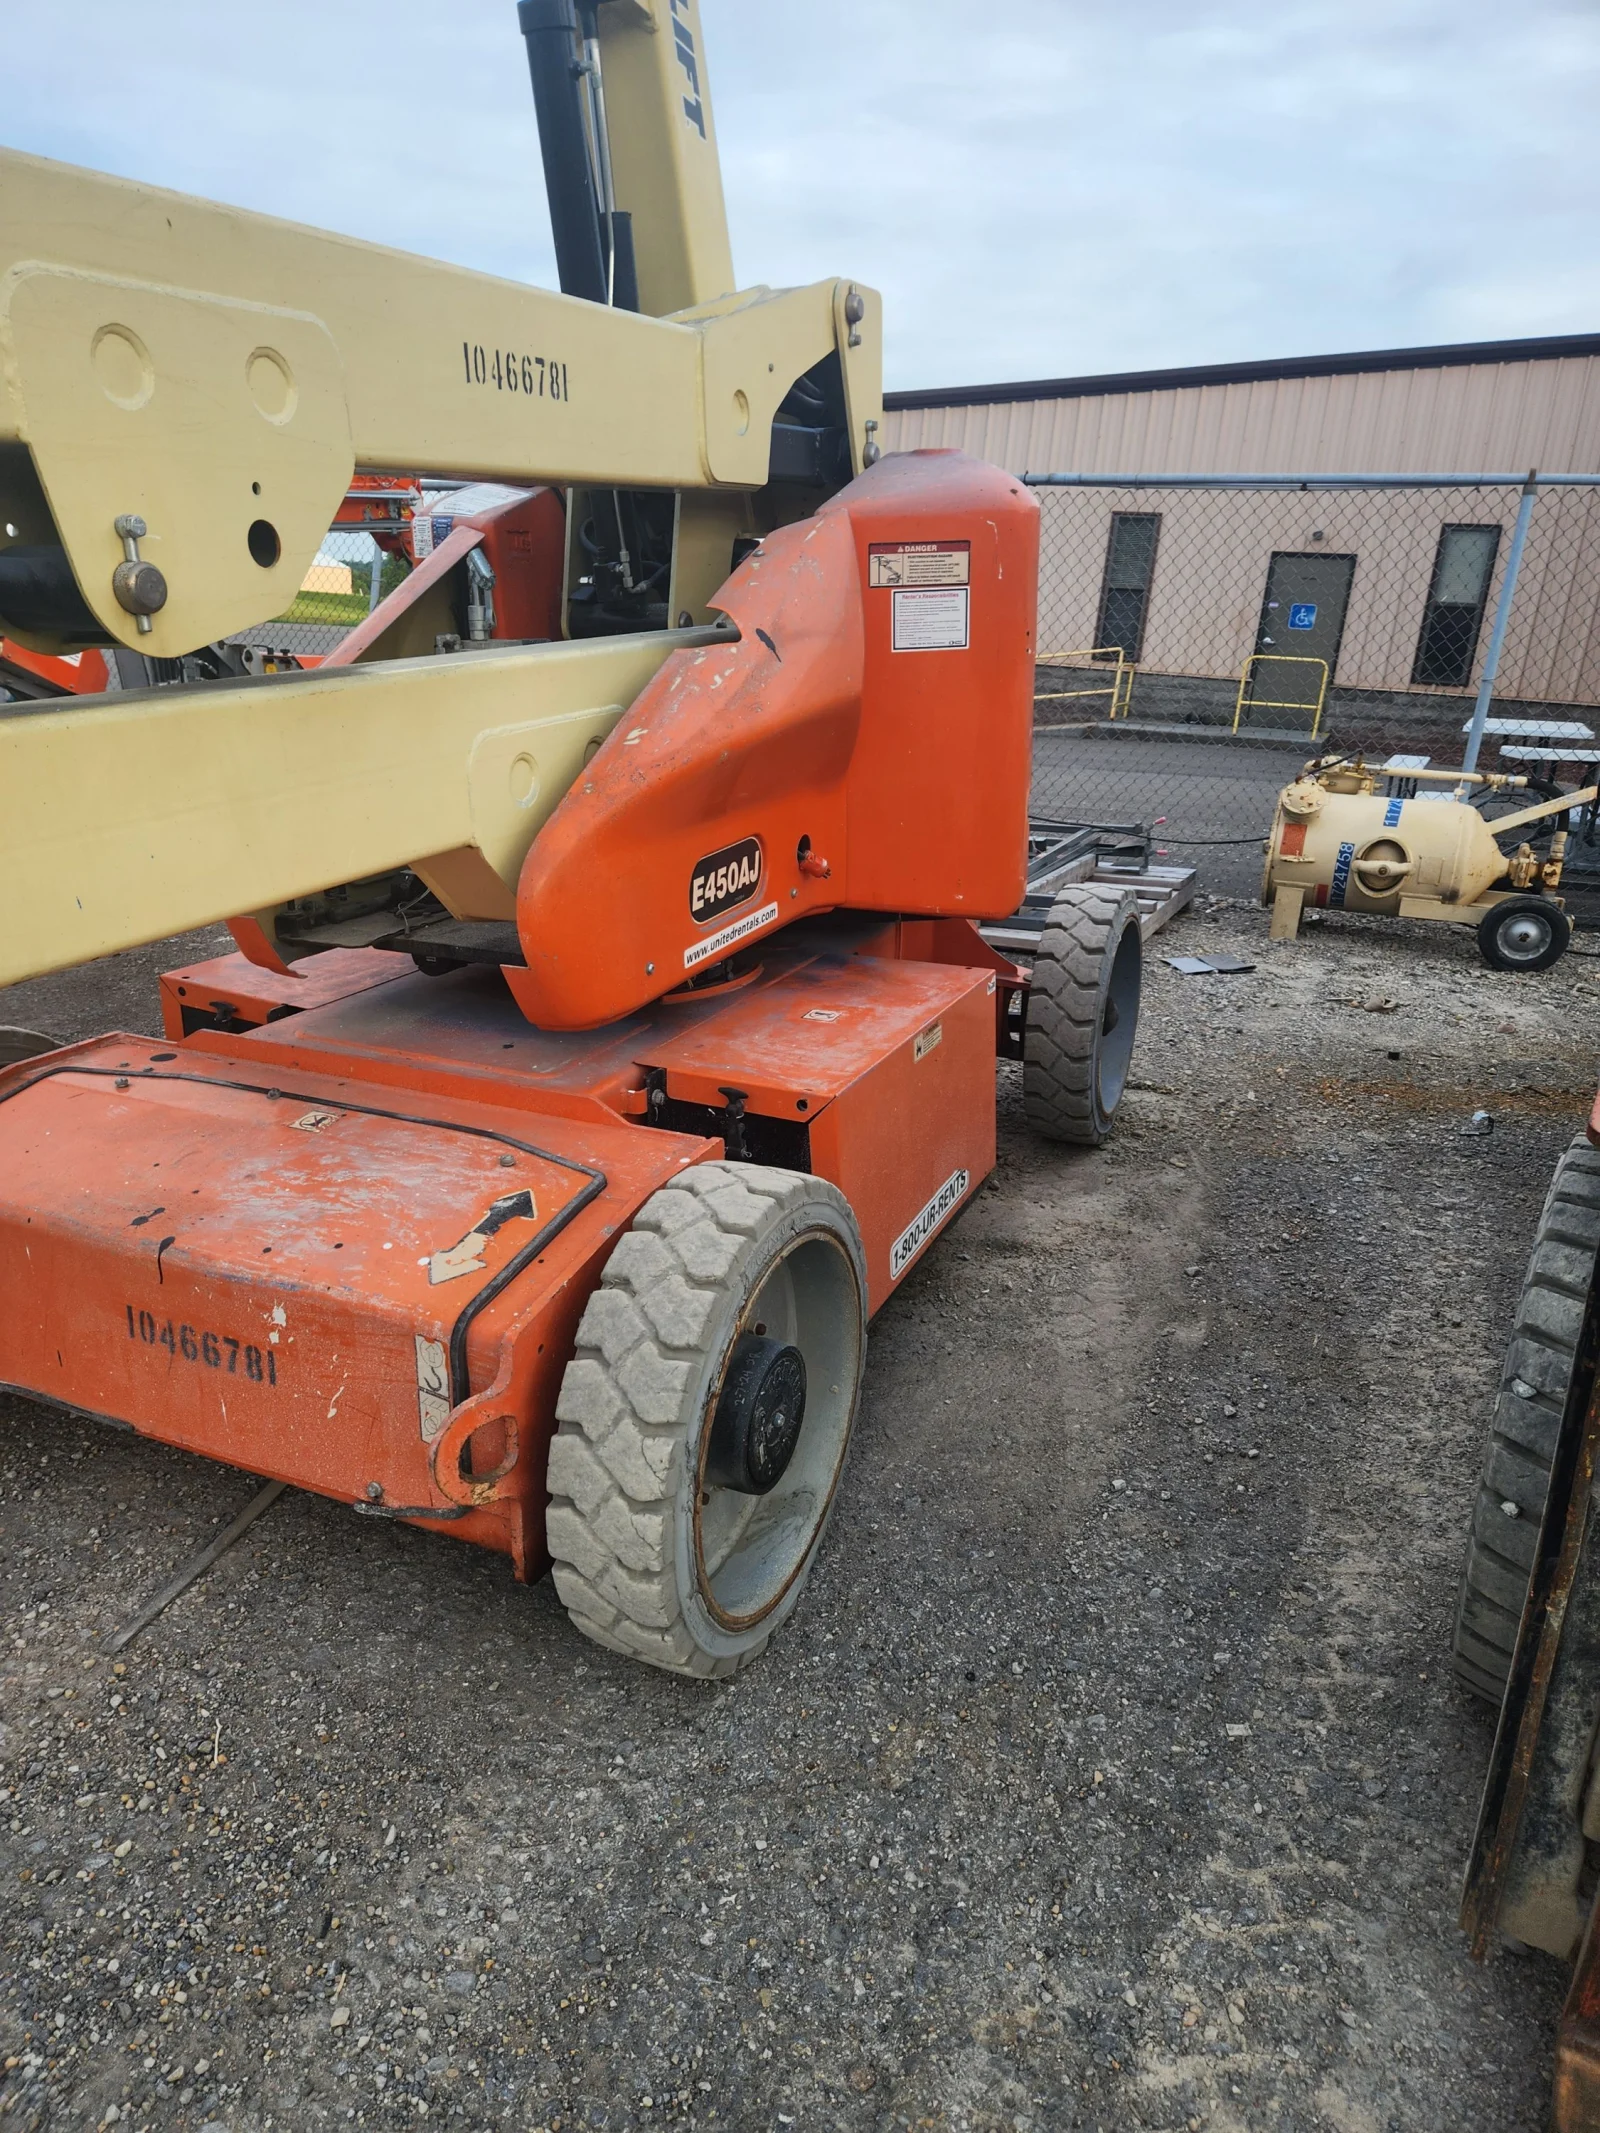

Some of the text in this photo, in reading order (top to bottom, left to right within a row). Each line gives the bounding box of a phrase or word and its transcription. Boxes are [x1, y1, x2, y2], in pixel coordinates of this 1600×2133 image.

[669, 0, 706, 140] IFT
[463, 342, 568, 402] 10466781
[692, 850, 760, 912] E450AJ
[686, 907, 776, 964] www.unitedrentals.com
[894, 1169, 966, 1269] 1-800-UR-RENTS
[126, 1305, 276, 1386] 10466781
